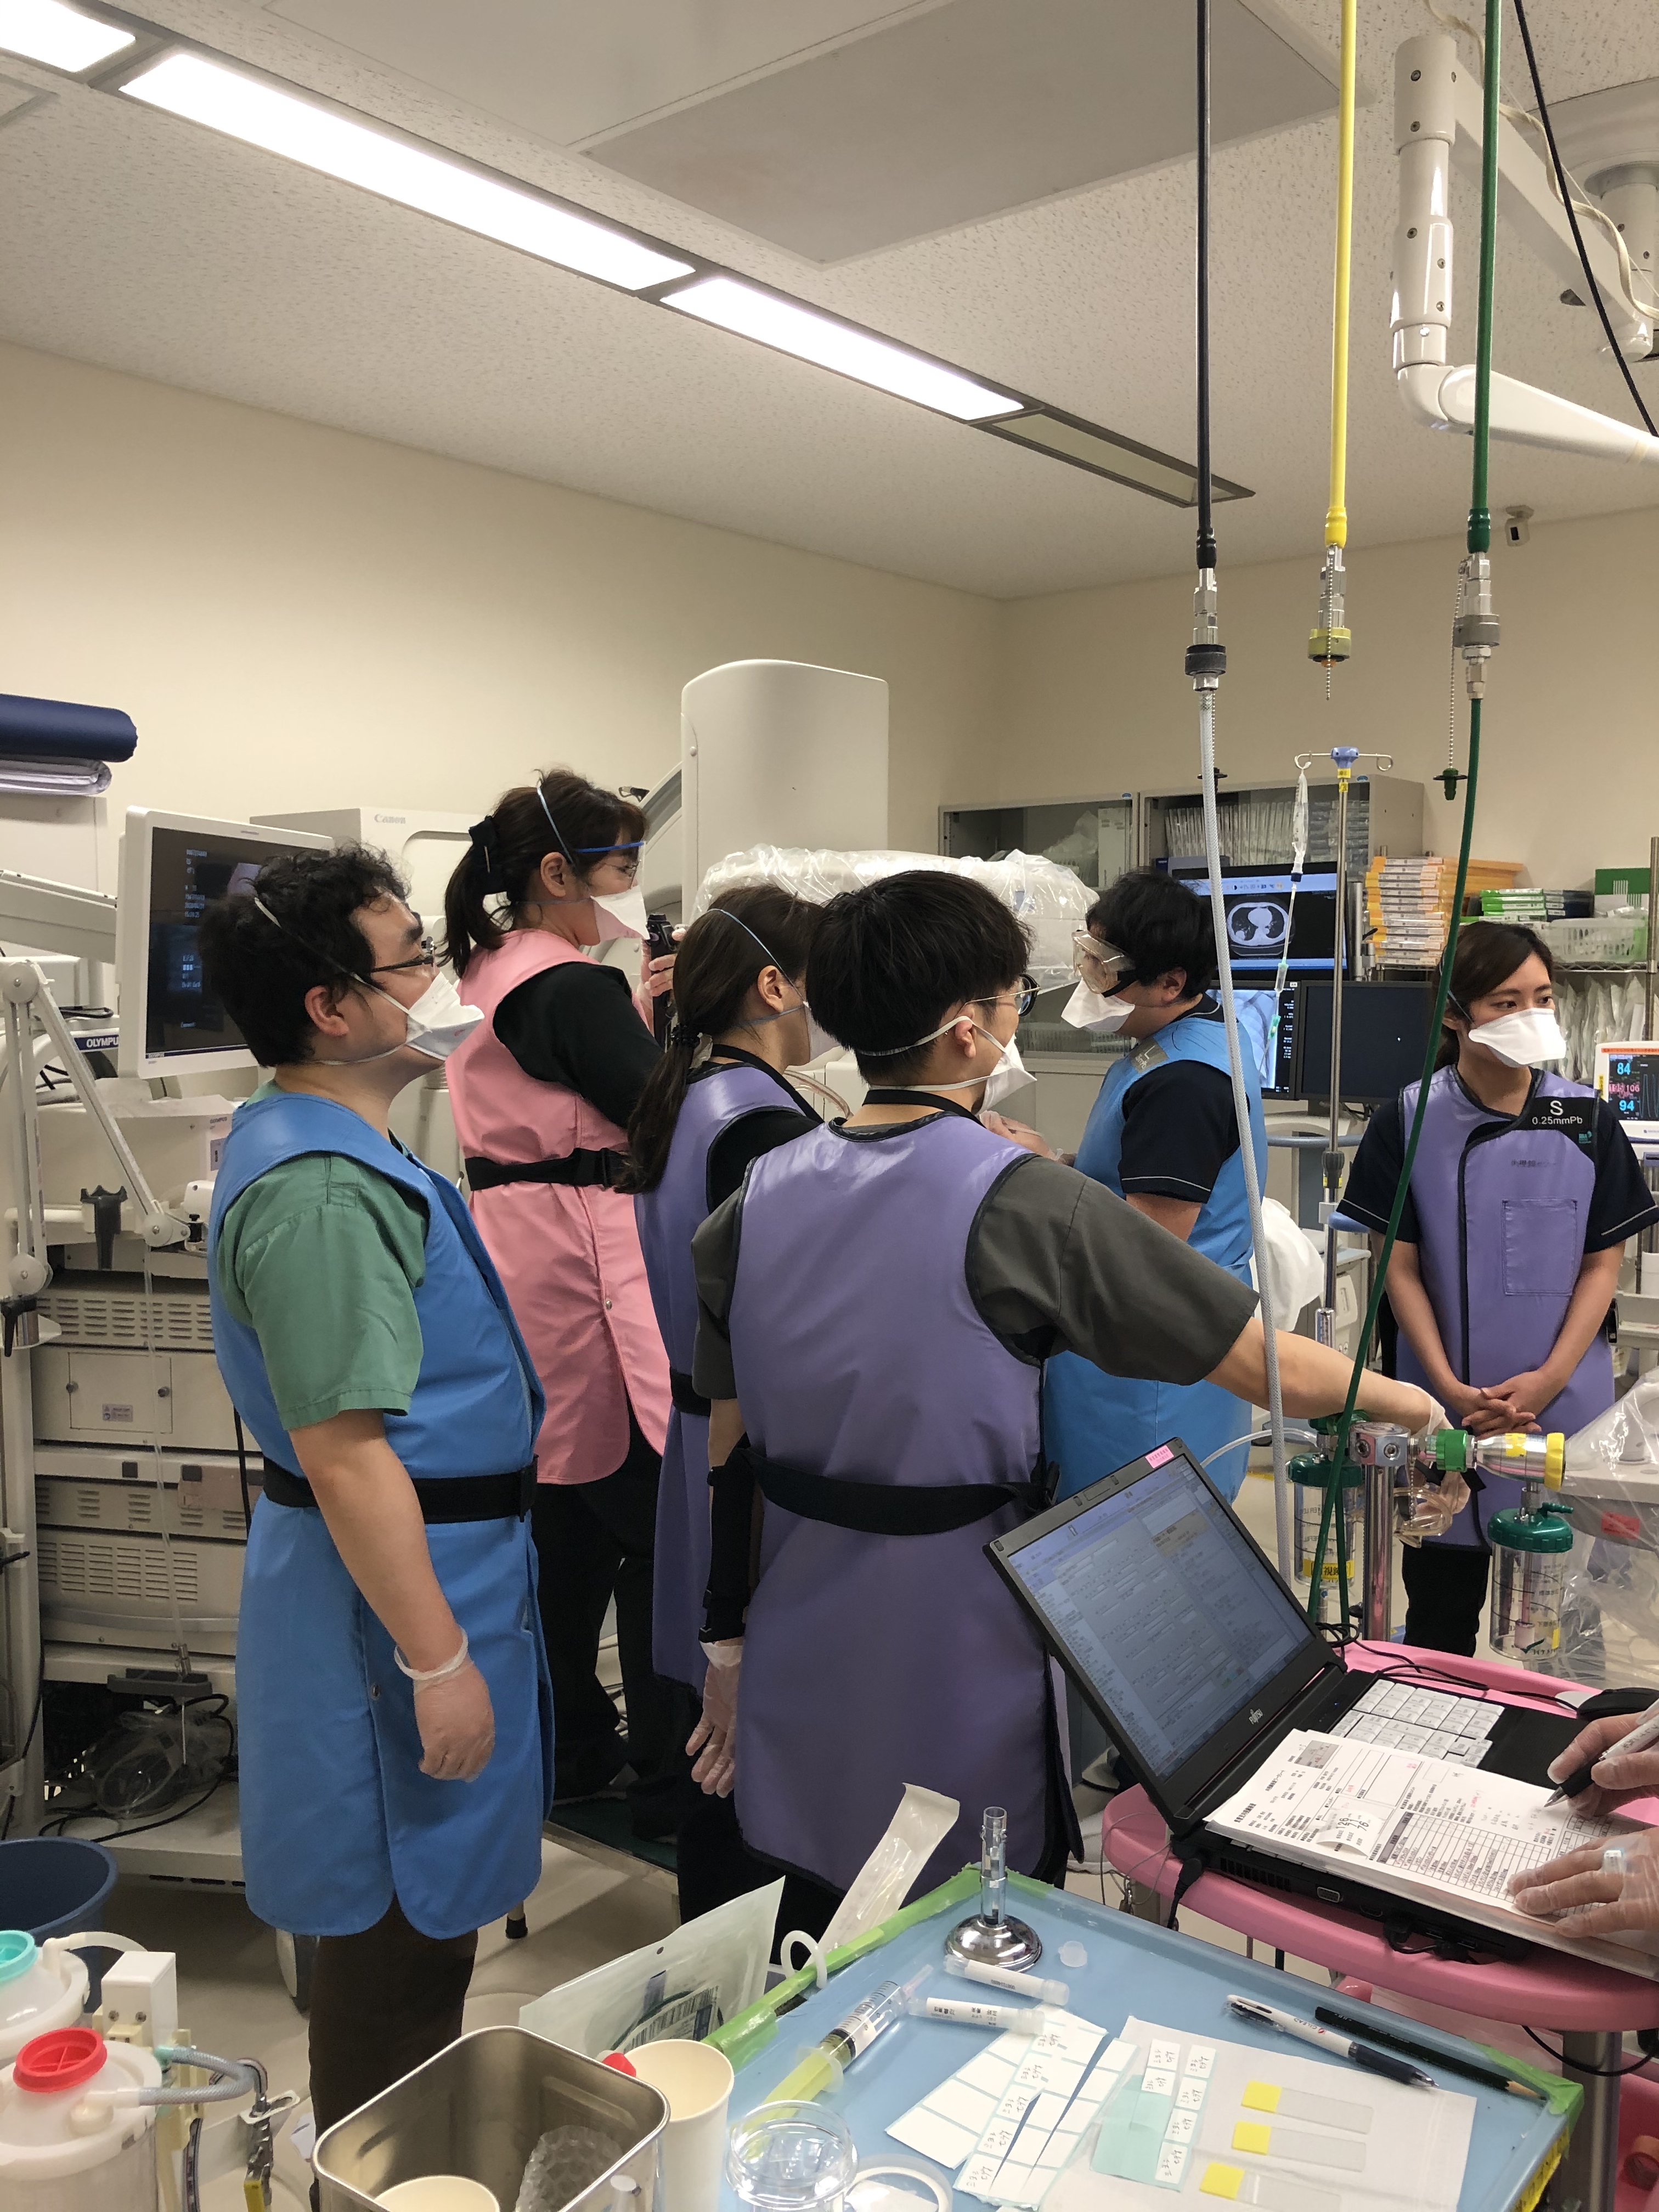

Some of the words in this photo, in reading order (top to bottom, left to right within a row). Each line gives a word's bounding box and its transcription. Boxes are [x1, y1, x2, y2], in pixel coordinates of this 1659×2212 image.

[374, 814, 405, 824] Canon
[1144, 1045, 1156, 1059] L
[1617, 1062, 1631, 1075] 84
[1627, 1084, 1640, 1092] 106
[1550, 1100, 1564, 1116] S
[1619, 1100, 1634, 1111] 94
[1532, 1116, 1583, 1125] 0.25mmPb
[1336, 1818, 1349, 1829] 126
[1357, 1821, 1369, 1831] 76
[1294, 2017, 1317, 2030] GILEAD
